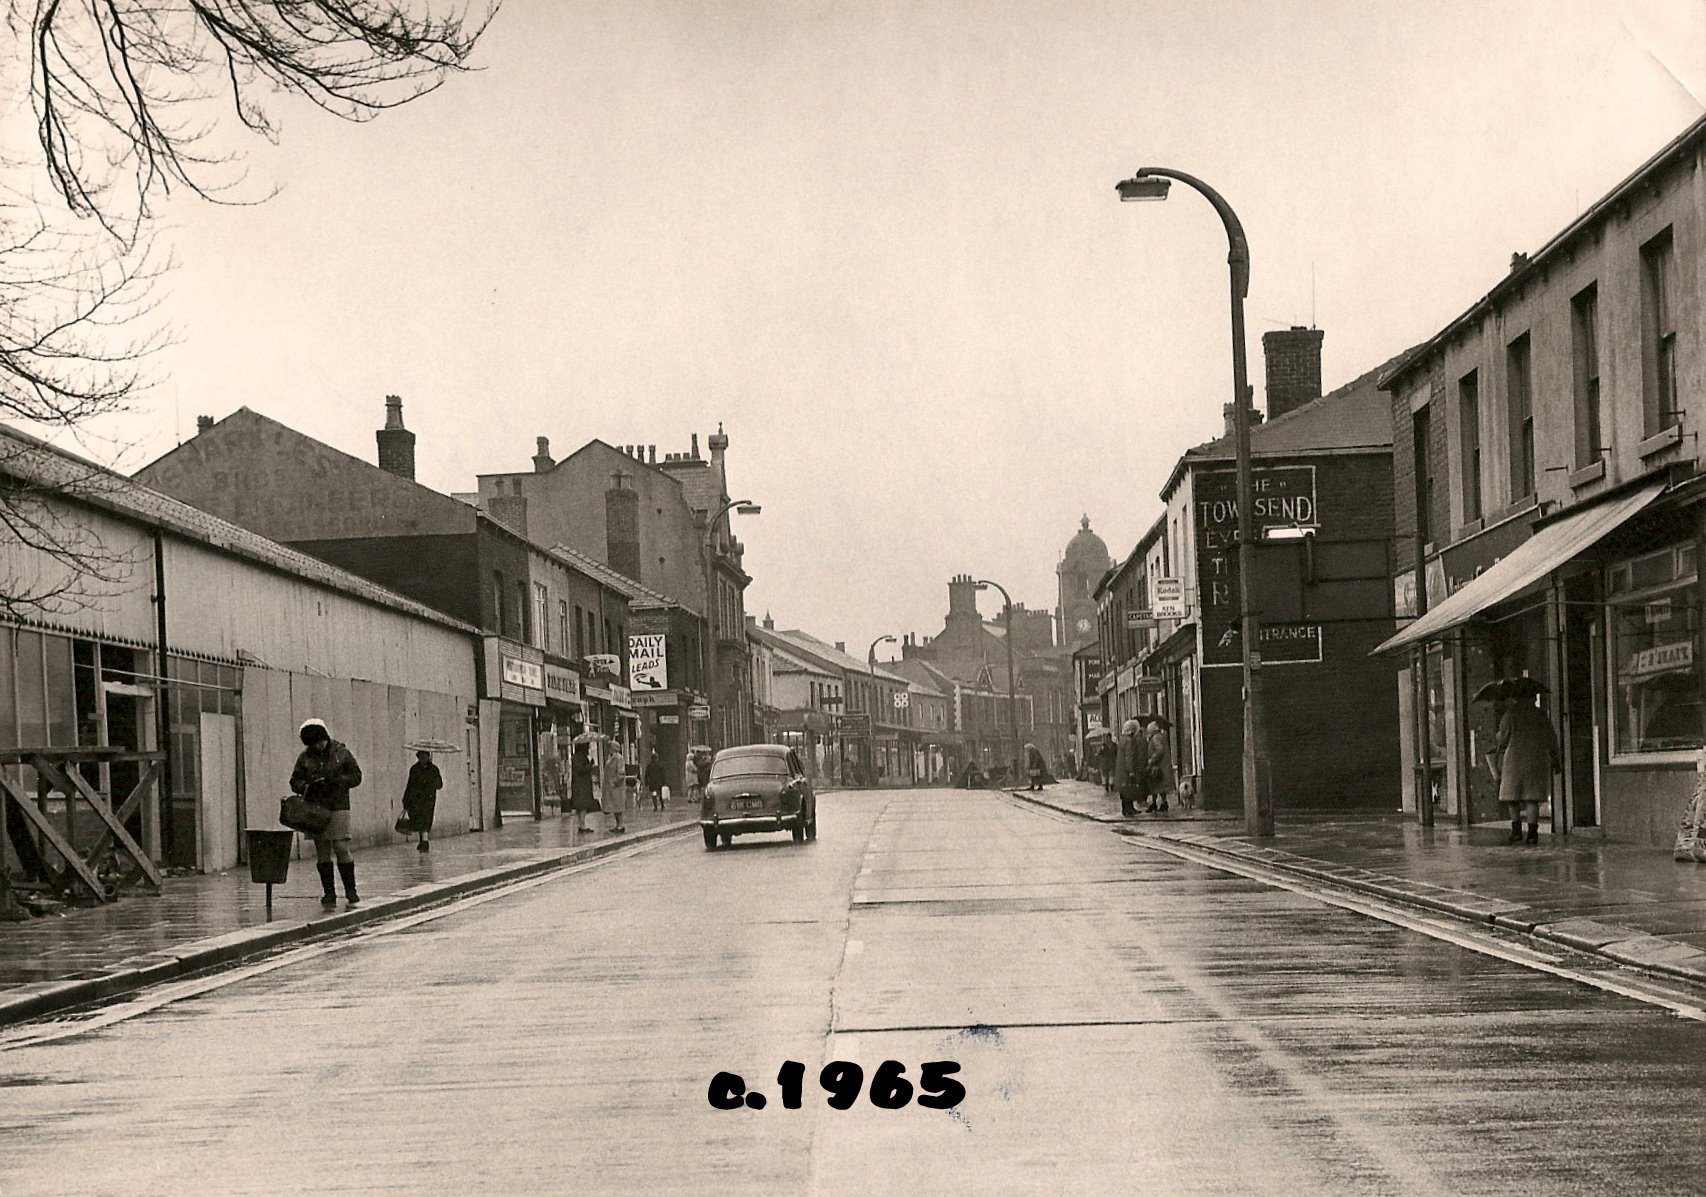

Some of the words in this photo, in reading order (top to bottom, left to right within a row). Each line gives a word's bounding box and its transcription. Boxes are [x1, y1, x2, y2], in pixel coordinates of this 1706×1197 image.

[1200, 496, 1312, 528] TOWSEND
[629, 637, 663, 648] DAILY
[629, 648, 664, 659] MAIL
[632, 659, 660, 673] LEADS
